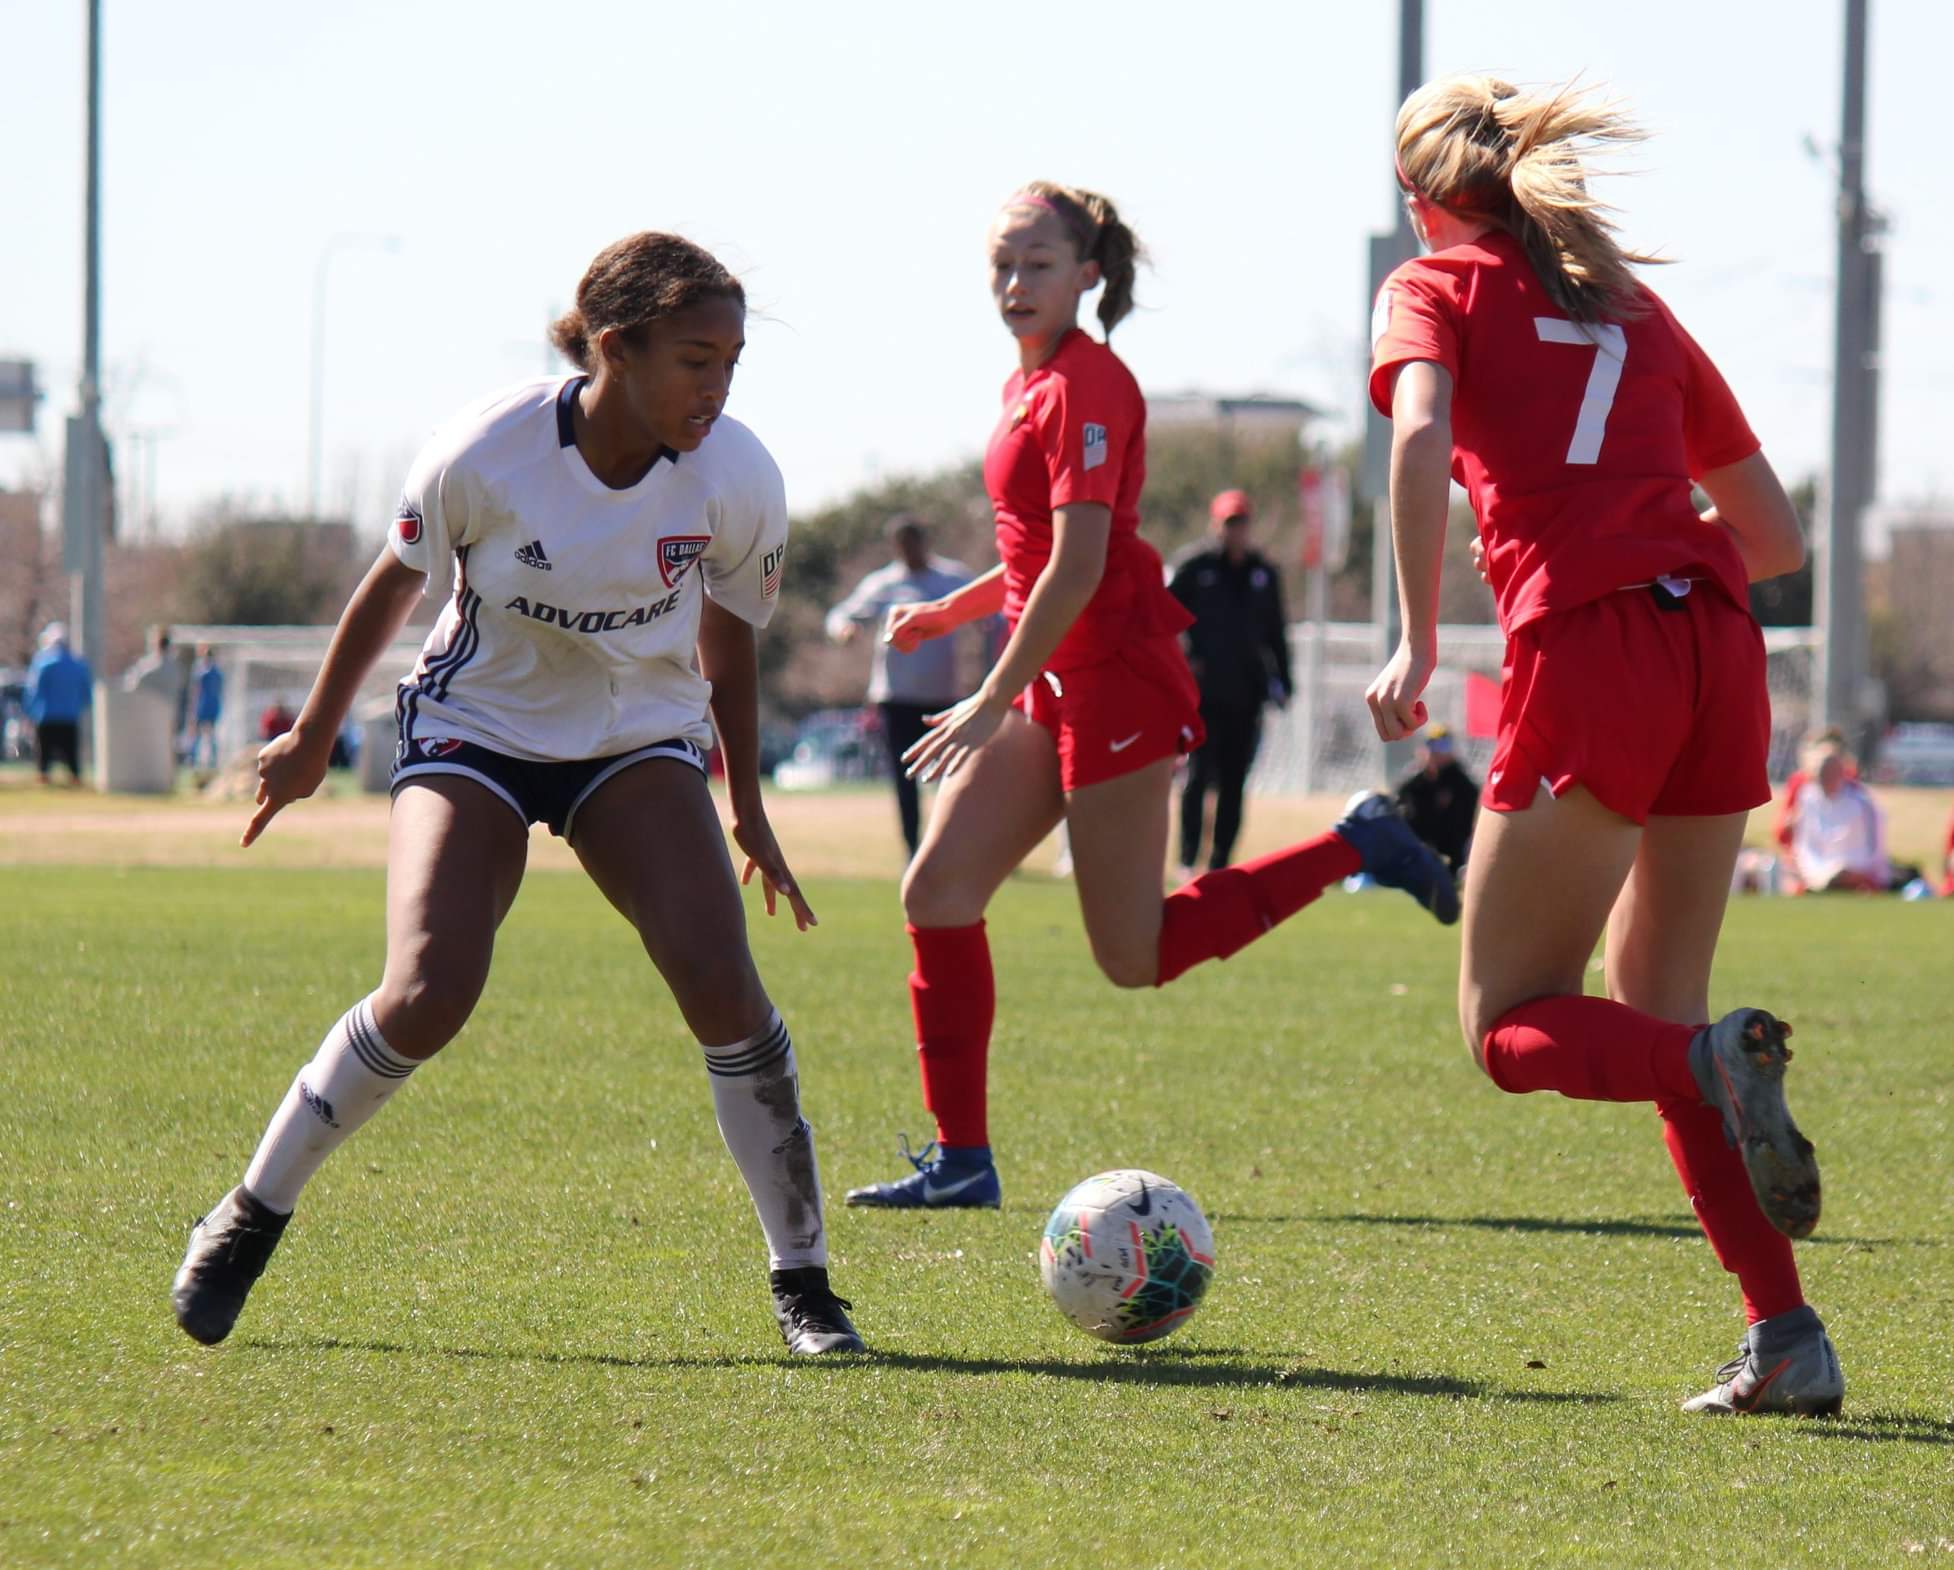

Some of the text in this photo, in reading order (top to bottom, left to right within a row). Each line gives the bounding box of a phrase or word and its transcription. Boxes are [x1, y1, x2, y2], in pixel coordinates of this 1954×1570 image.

[1533, 317, 1628, 465] 7
[514, 550, 552, 571] adidas
[504, 589, 681, 634] ADVOCARE
